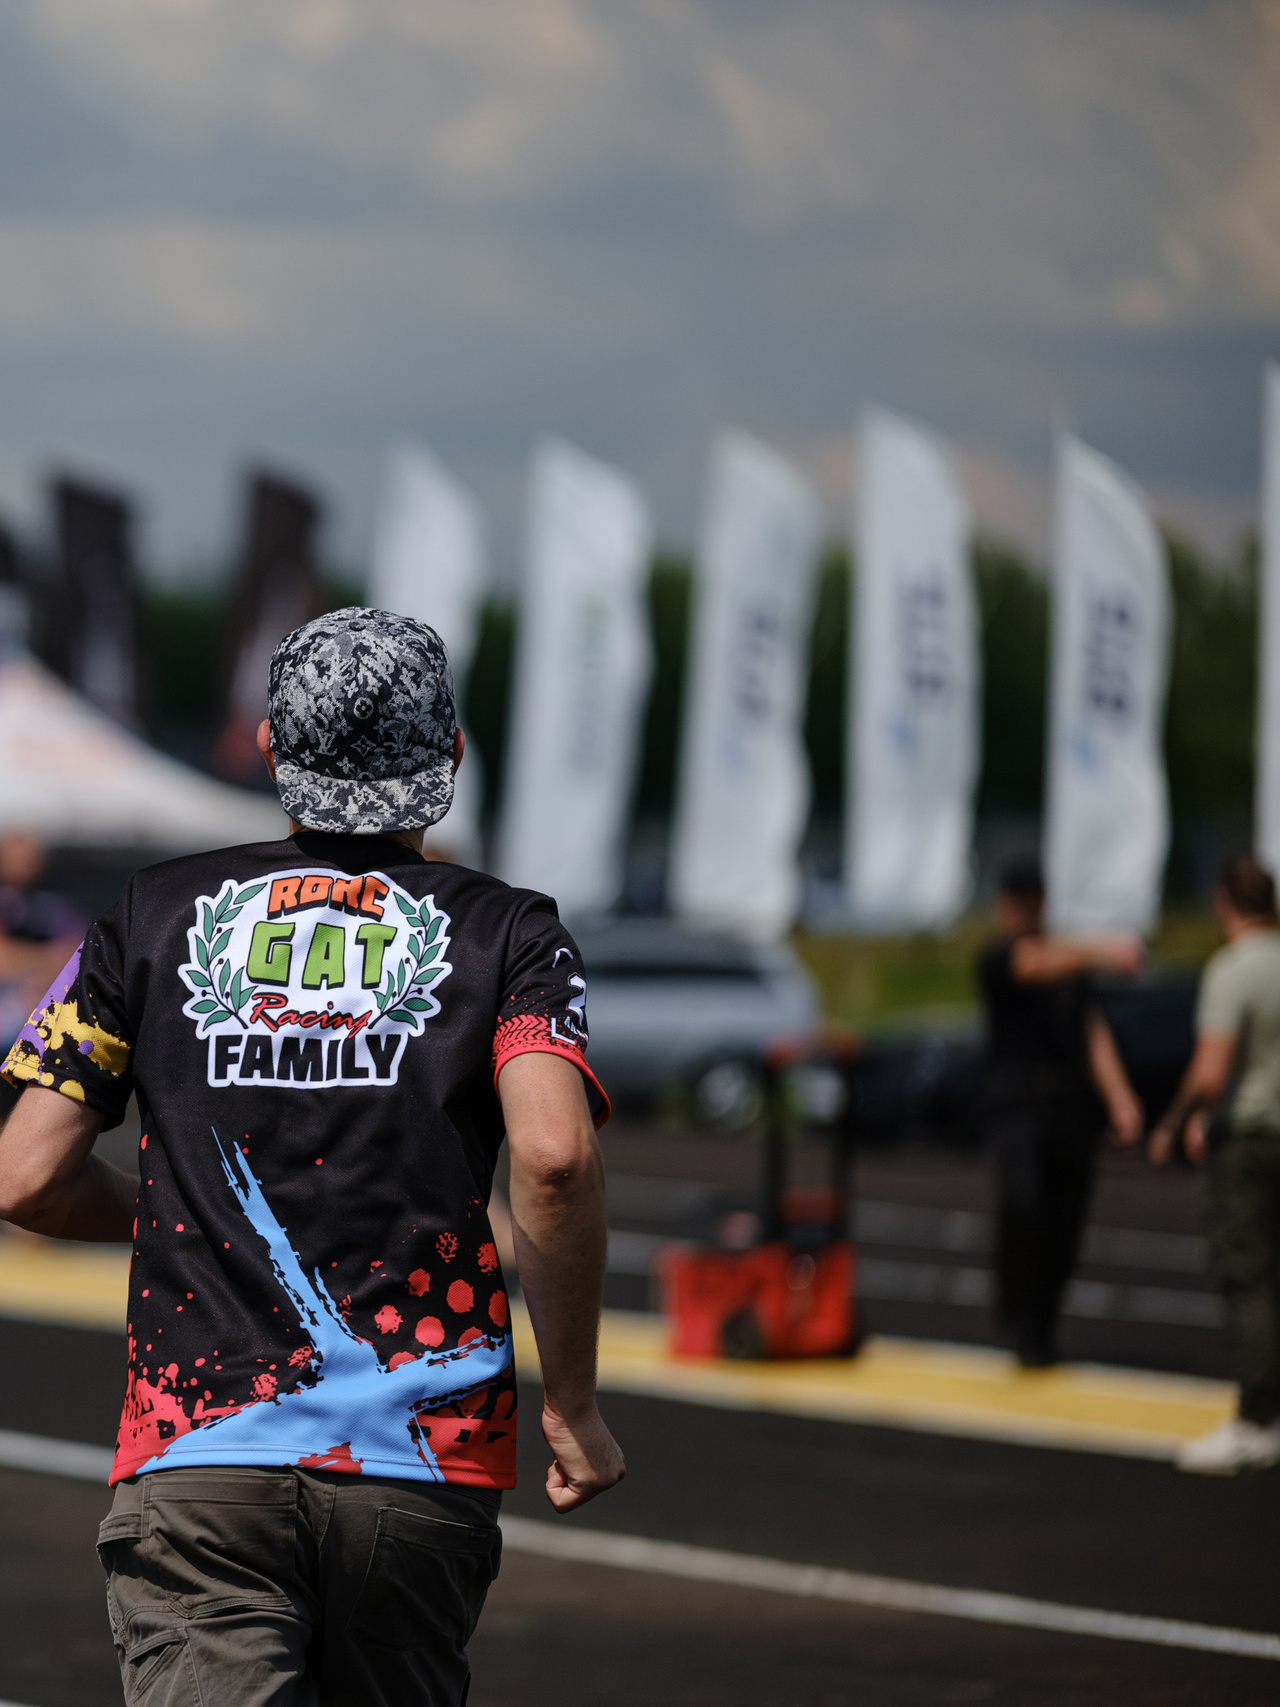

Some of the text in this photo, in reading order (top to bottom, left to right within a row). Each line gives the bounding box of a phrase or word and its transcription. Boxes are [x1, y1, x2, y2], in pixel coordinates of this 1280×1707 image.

[246, 921, 398, 989] GAT
[249, 991, 373, 1039] Racing
[214, 1034, 401, 1082] FAMILY
